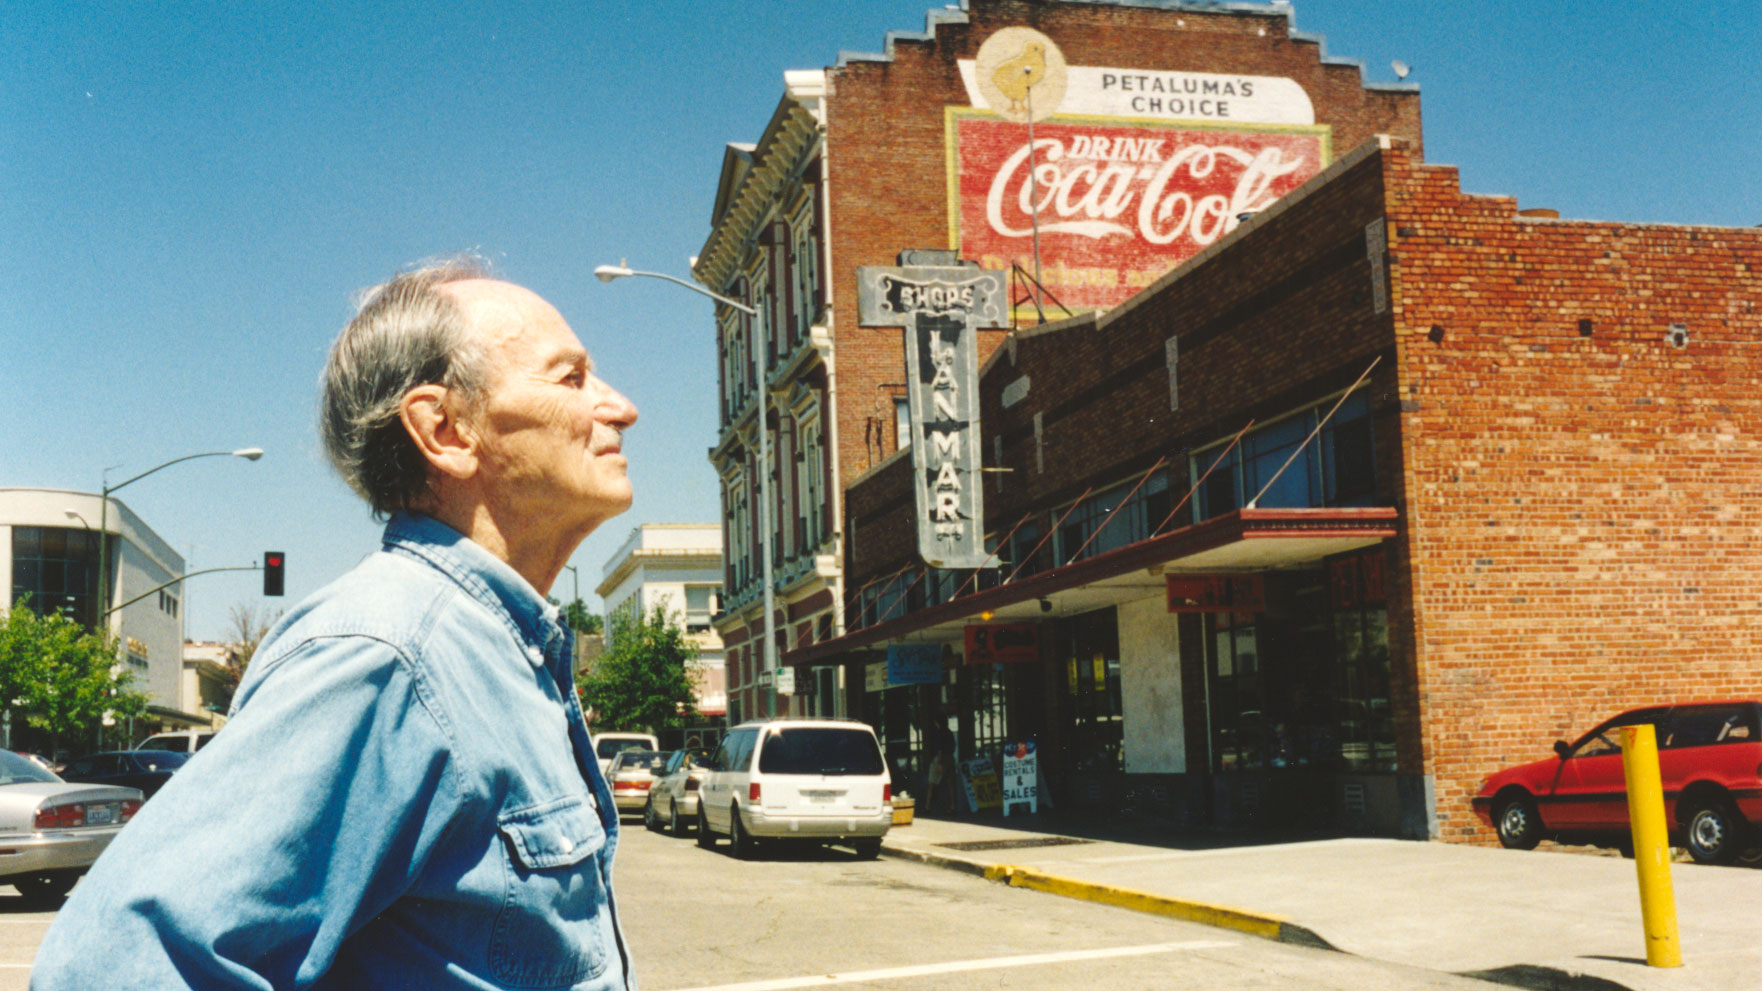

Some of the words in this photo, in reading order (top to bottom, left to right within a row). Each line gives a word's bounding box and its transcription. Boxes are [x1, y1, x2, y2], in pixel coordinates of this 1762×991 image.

[1102, 73, 1254, 97] PETALUMA'S
[1131, 96, 1230, 117] CHOICE
[1067, 135, 1167, 162] DRINK
[987, 137, 1304, 244] Coca-Col
[900, 285, 974, 307] SHOPS
[1004, 758, 1035, 769] COSTUME
[1004, 766, 1035, 777] RENTALS
[1016, 776, 1024, 786] &
[1003, 786, 1037, 801] SALES
